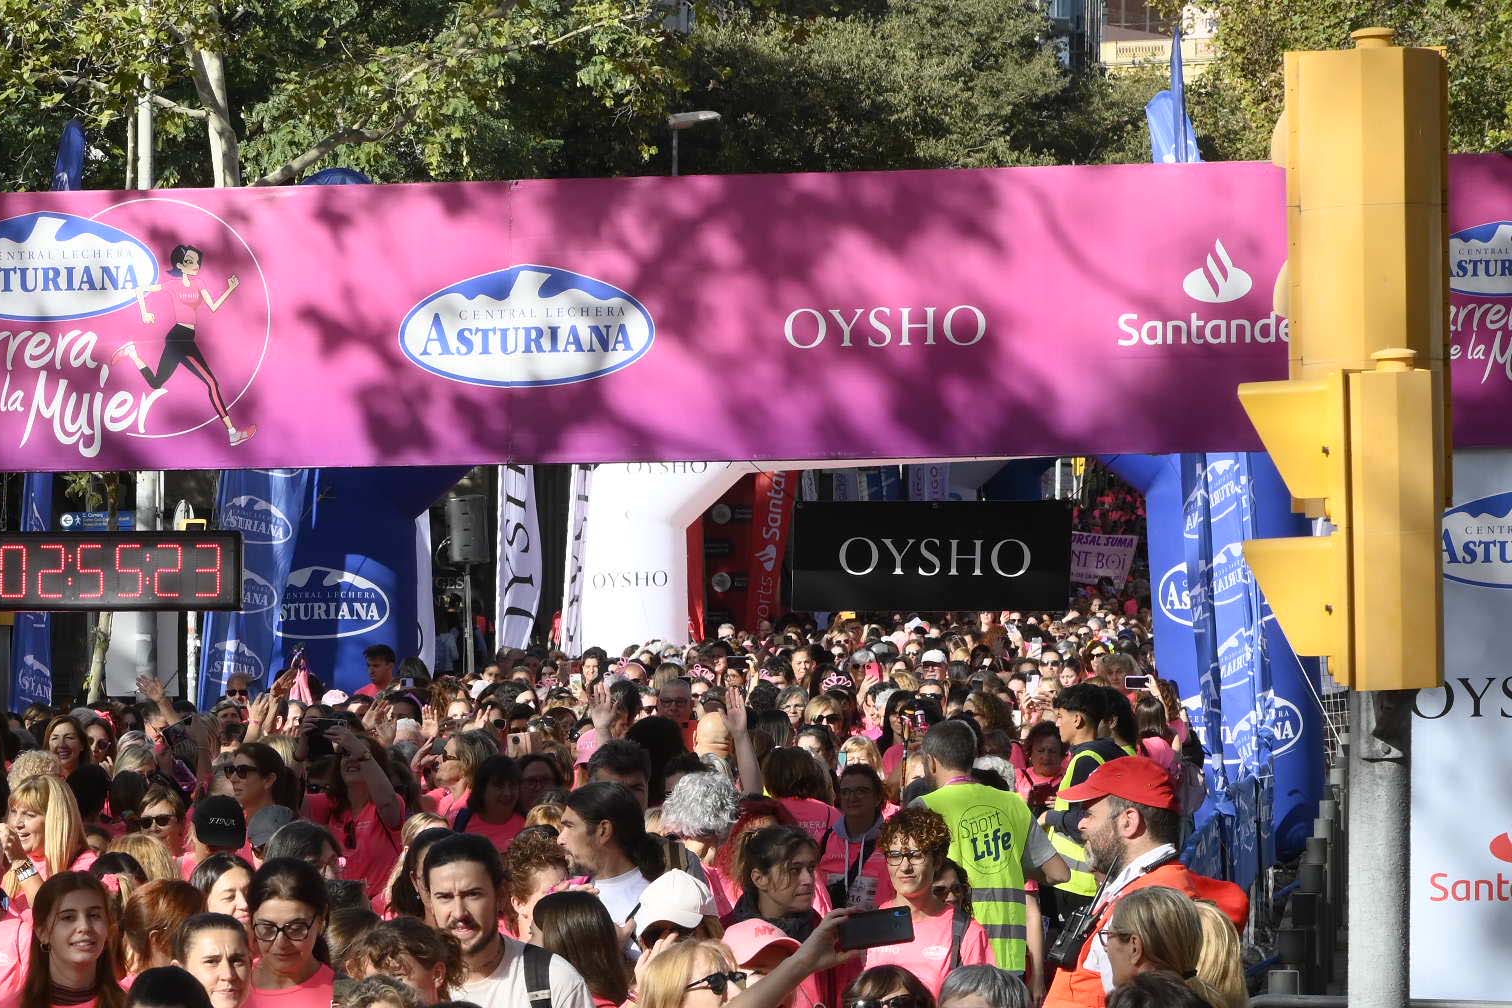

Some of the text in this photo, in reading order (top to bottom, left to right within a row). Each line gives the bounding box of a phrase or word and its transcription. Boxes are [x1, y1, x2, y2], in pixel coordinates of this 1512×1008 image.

[458, 306, 626, 320] CENTRAL LECHERA
[783, 304, 987, 349] OYSHO
[1117, 311, 1289, 347] Santande
[420, 312, 634, 358] ASTURIANA
[0, 375, 25, 412] la
[21, 364, 168, 458] Mujer
[838, 535, 1033, 579] OYSHO
[1104, 536, 1134, 548] SUMA
[0, 544, 222, 599] 02:55:23
[592, 570, 670, 592] OYSHO
[279, 602, 381, 622] STURIANA
[326, 591, 376, 599] LECHERA
[960, 808, 1003, 843] Sport
[970, 828, 1013, 862] Life
